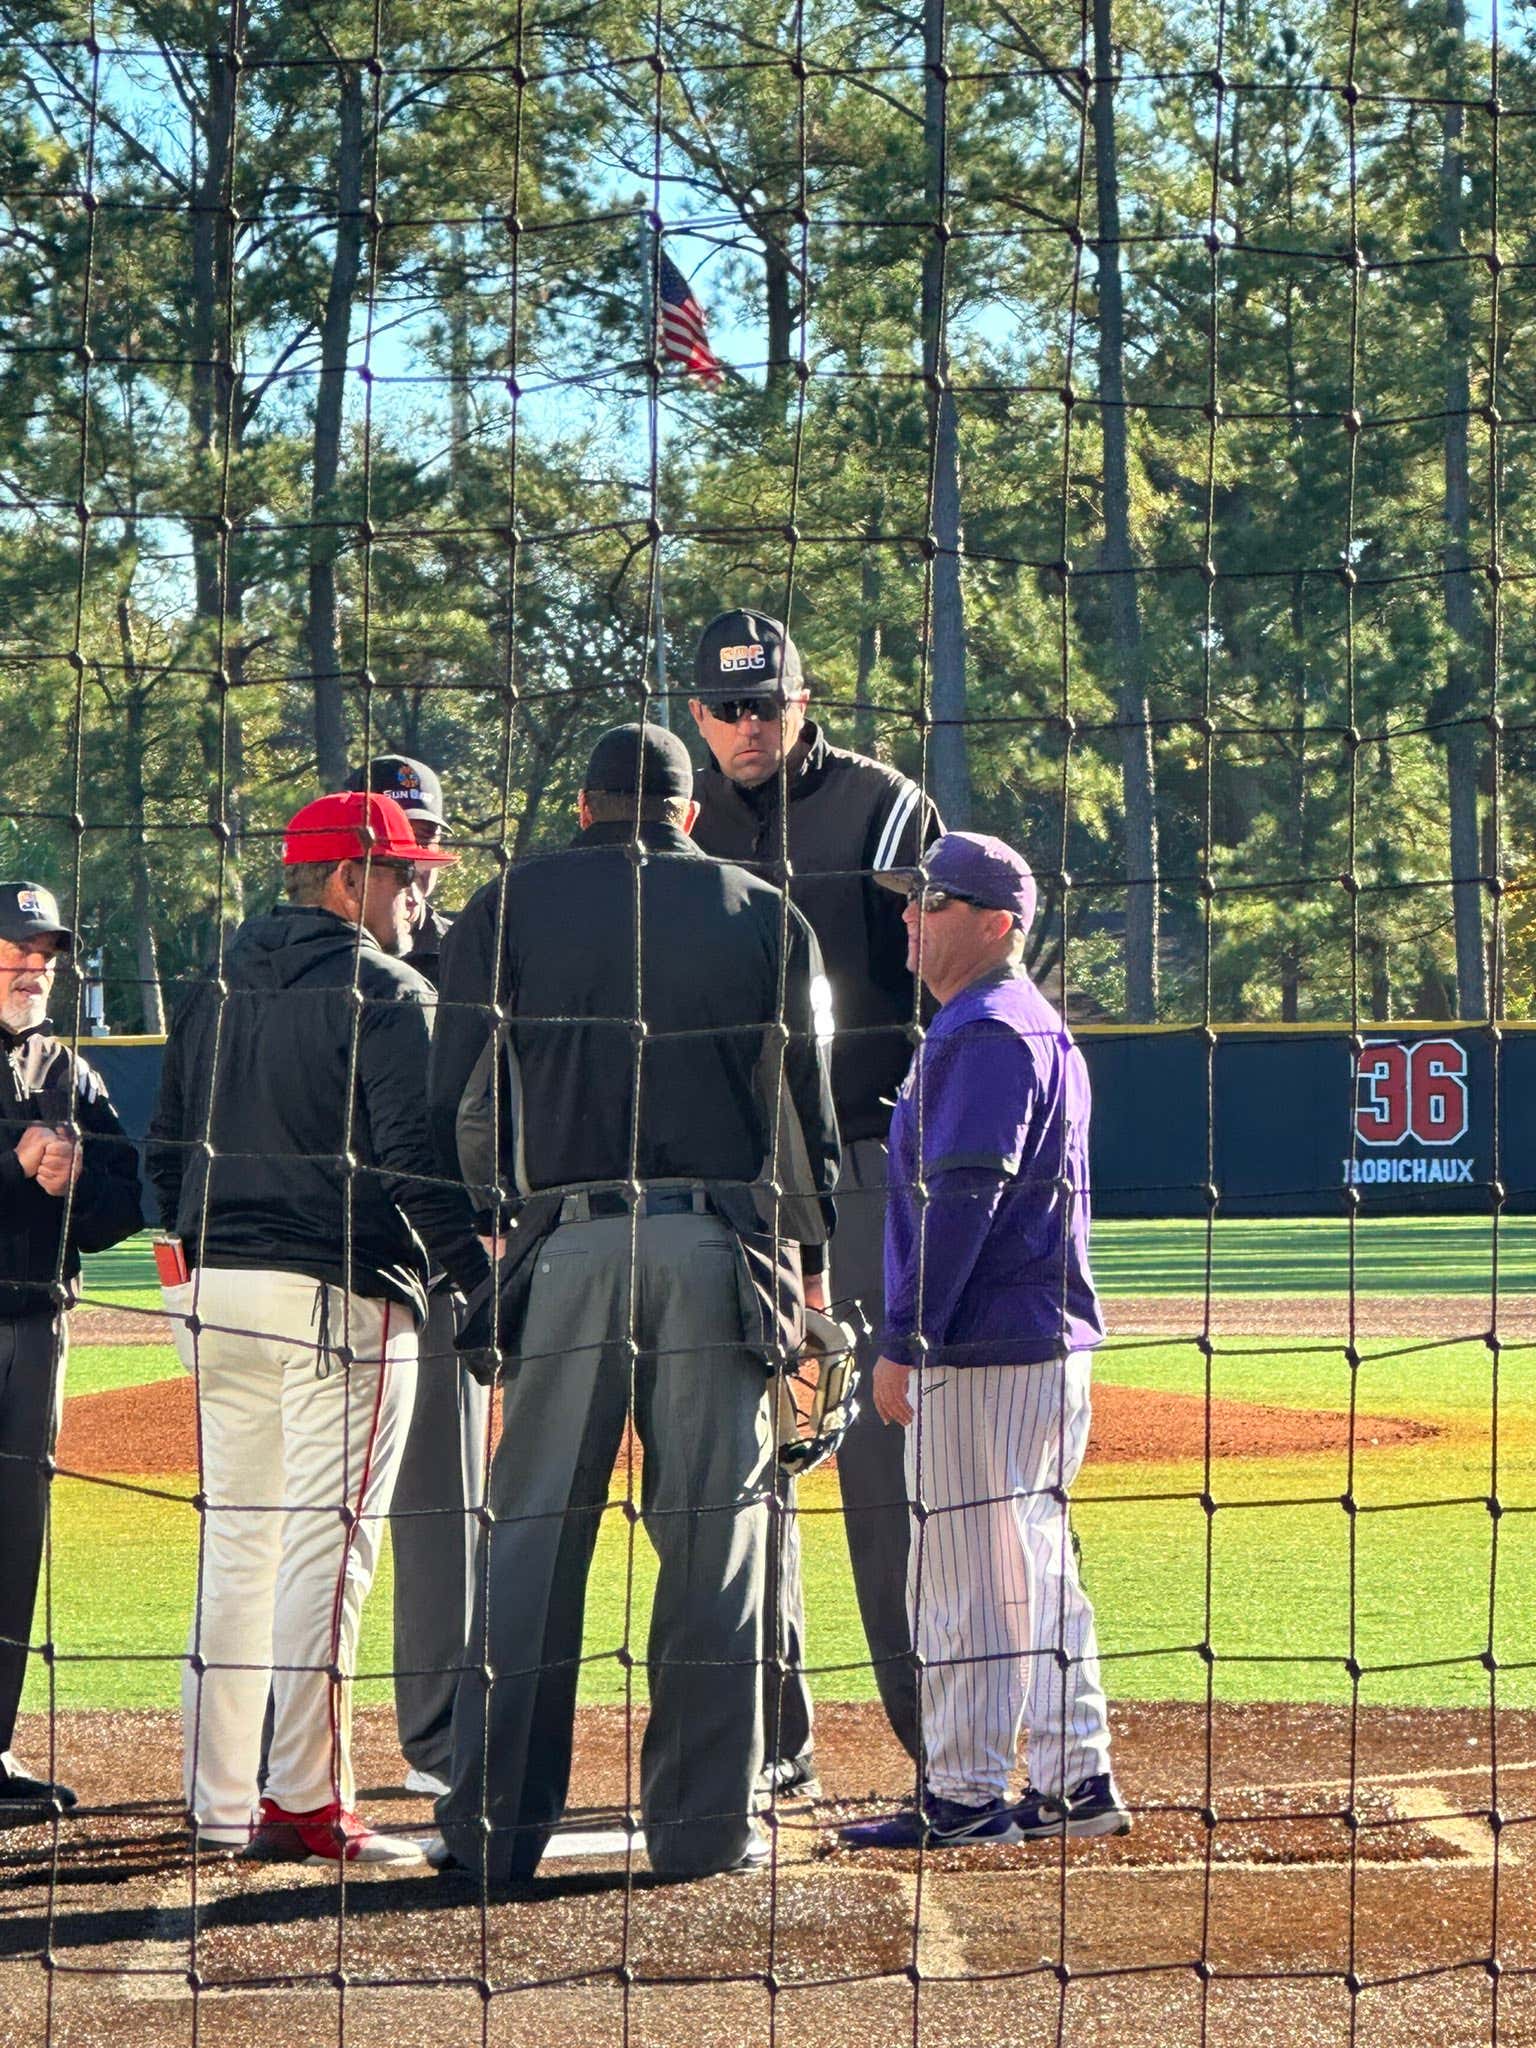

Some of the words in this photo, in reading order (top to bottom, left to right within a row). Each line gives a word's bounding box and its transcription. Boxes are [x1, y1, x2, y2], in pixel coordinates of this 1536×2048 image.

[720, 644, 766, 672] SBC
[1350, 1038, 1469, 1146] 36
[1342, 1158, 1475, 1183] ROBICHAUX
